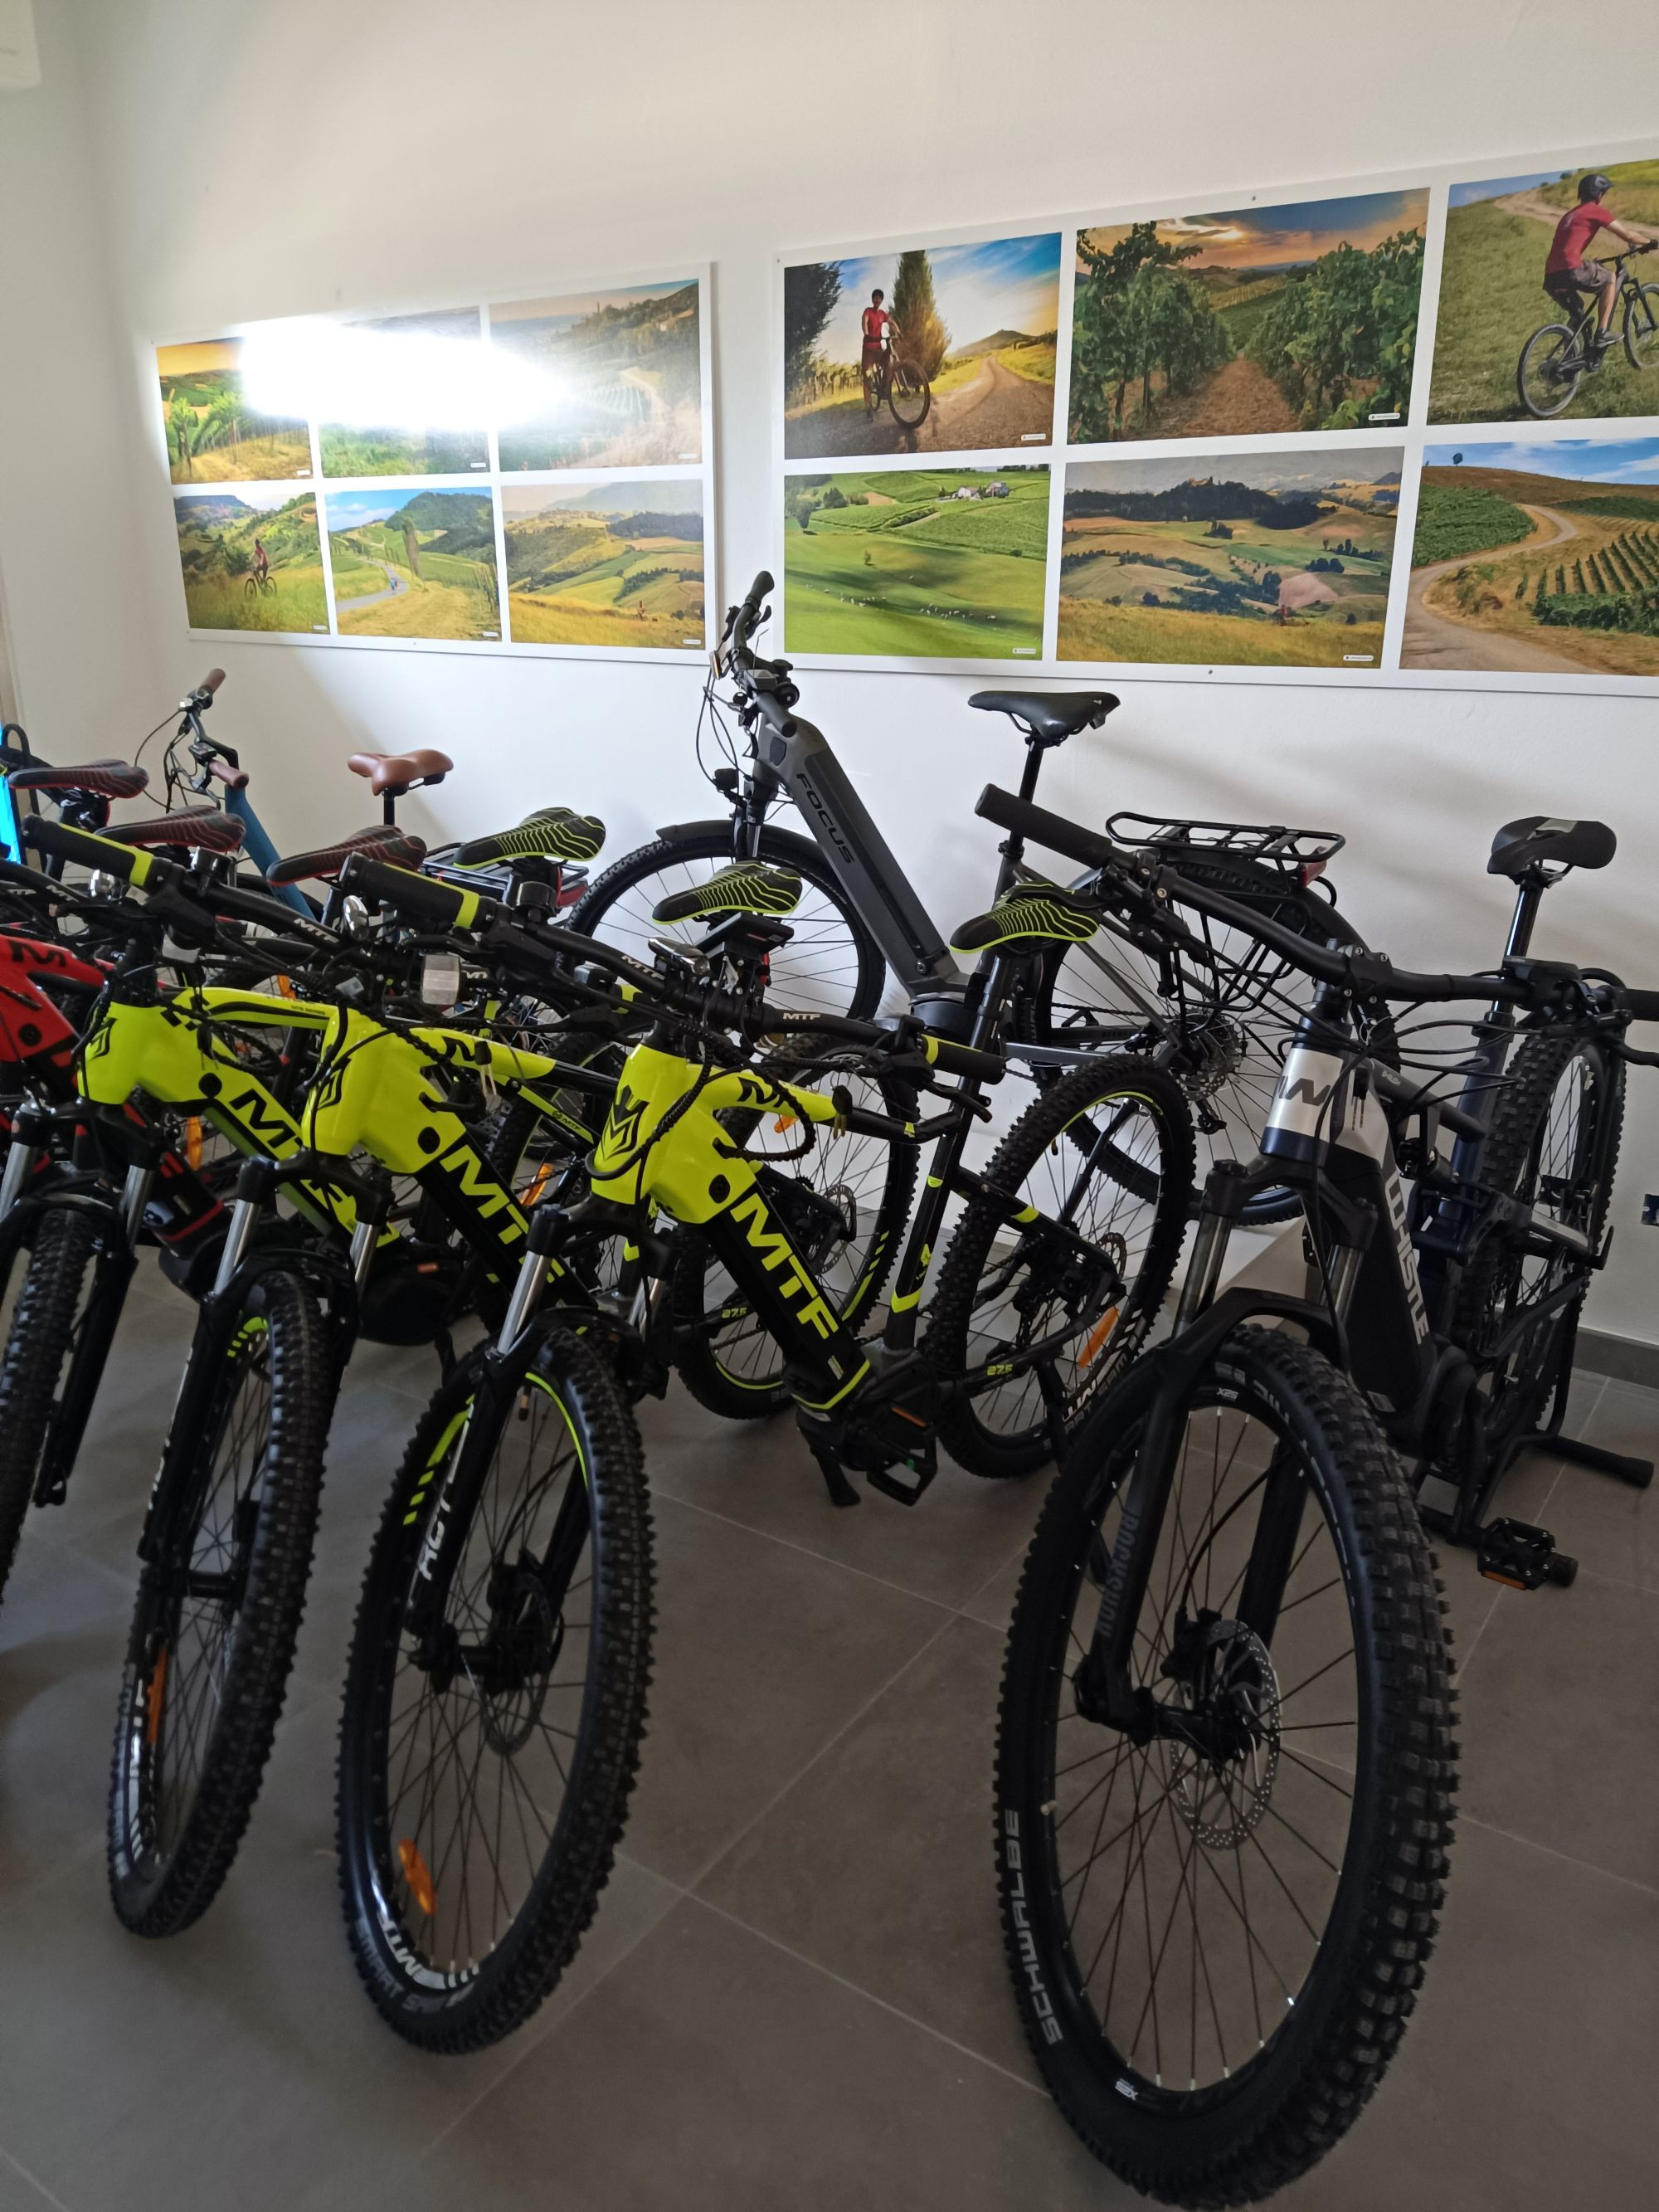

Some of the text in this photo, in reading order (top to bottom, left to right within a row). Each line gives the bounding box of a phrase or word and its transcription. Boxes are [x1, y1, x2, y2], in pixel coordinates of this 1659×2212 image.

[795, 772, 855, 864] FOCUS
[294, 918, 340, 944] MTF
[621, 955, 665, 981] MTF
[782, 1011, 822, 1021] MTF
[729, 1192, 839, 1340] MTF
[1384, 1172, 1430, 1346] WHISTLE
[1004, 1809, 1064, 2046] SCHWALBE
